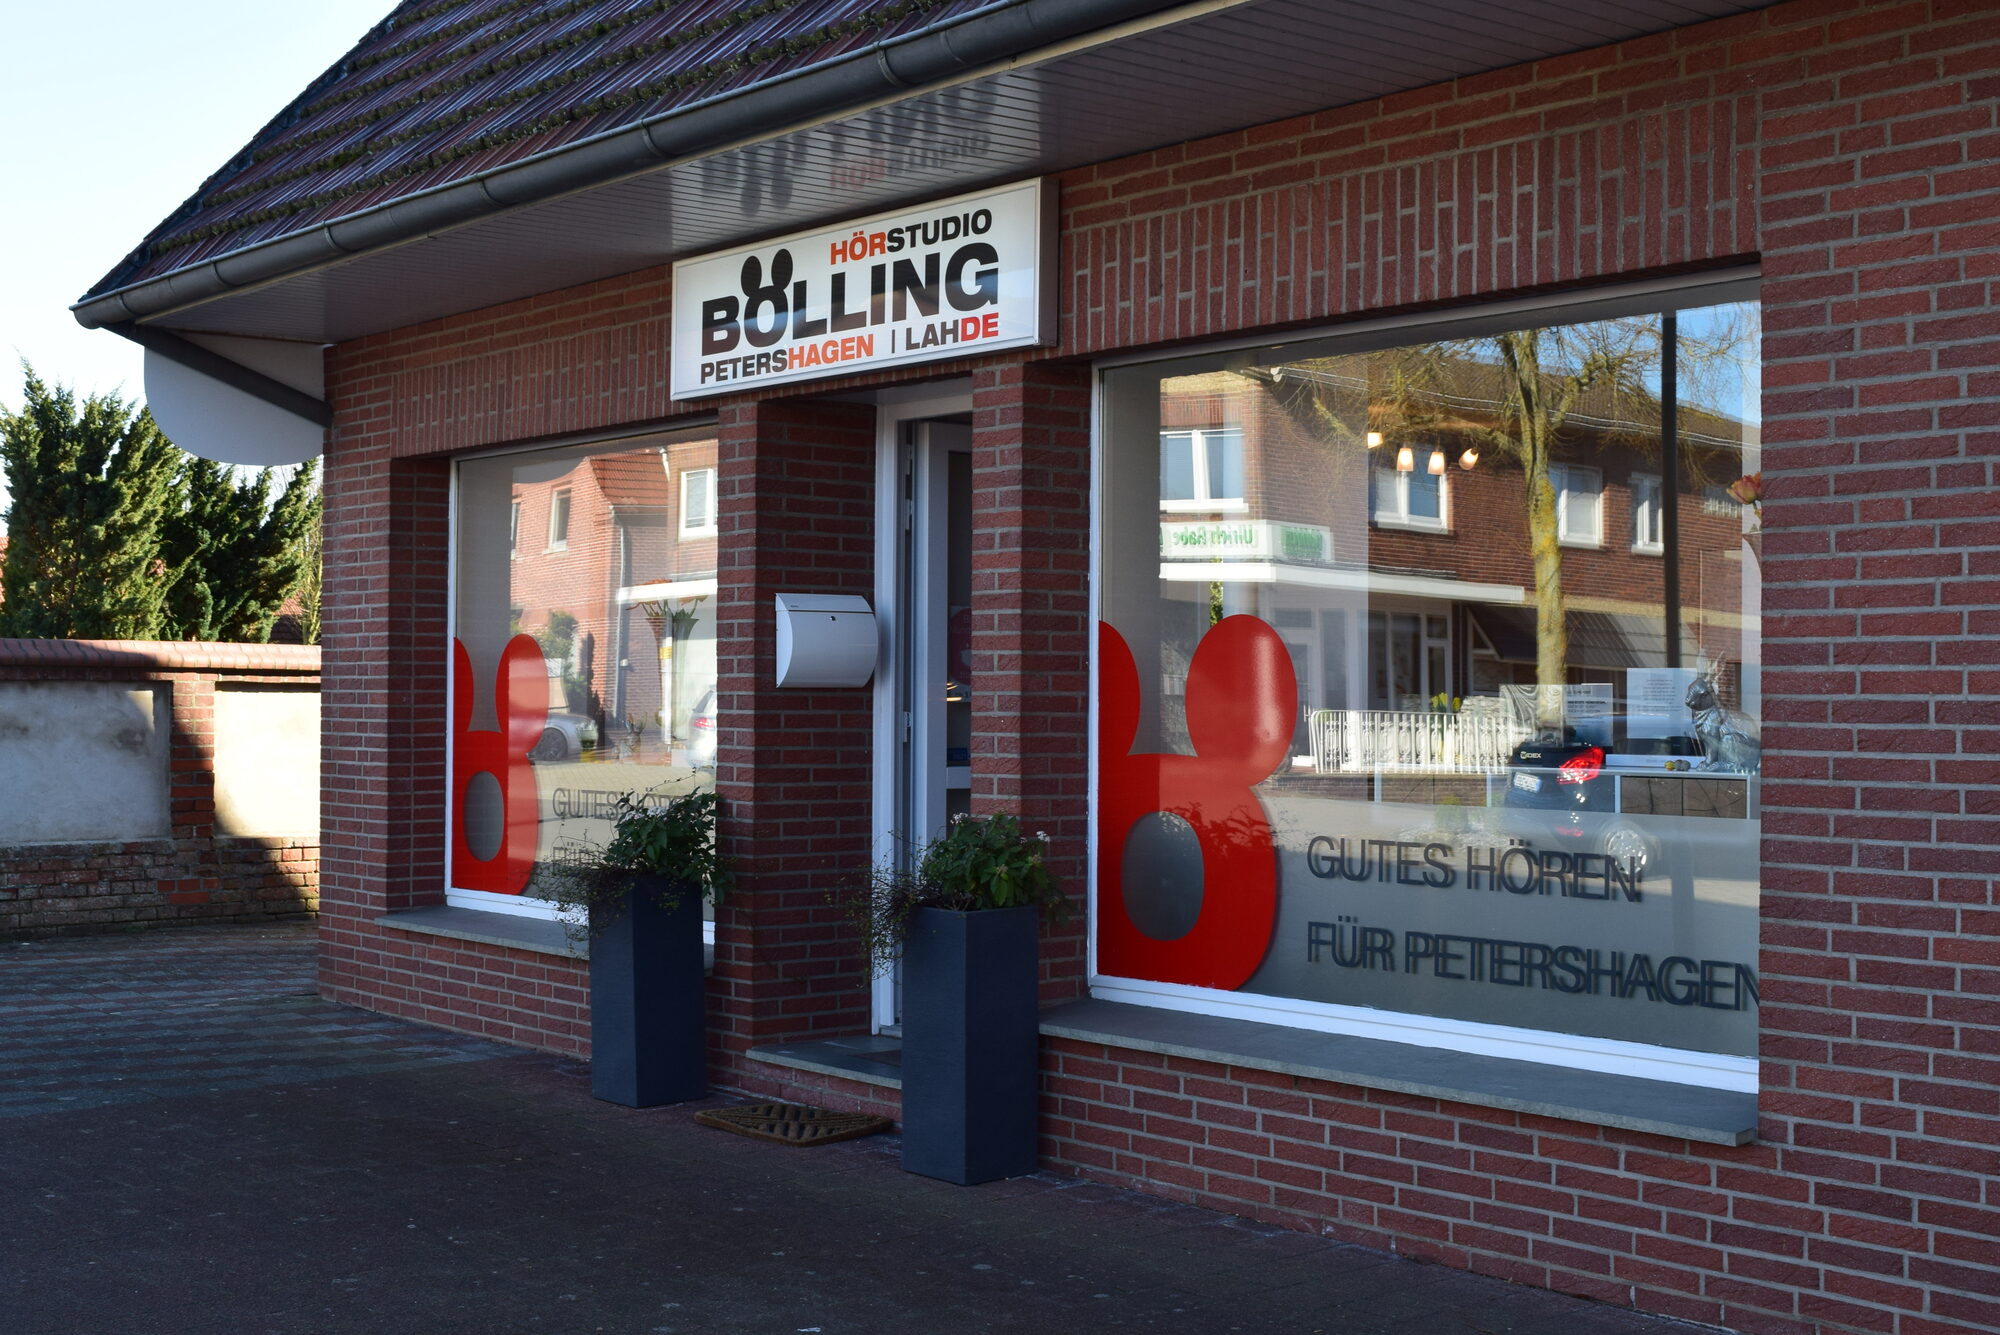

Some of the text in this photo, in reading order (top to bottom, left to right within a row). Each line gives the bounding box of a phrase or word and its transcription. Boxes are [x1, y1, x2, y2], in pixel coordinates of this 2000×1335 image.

[830, 208, 992, 265] HÖRSTUDIO
[701, 242, 999, 356] BÖLLING
[700, 333, 874, 384] PETERSHAGEN
[905, 312, 999, 351] LAHDE
[552, 787, 619, 821] GUTES
[1307, 835, 1641, 901] GUTES HÖREN
[1307, 915, 1760, 1010] FÜR PETERSHAGEN
